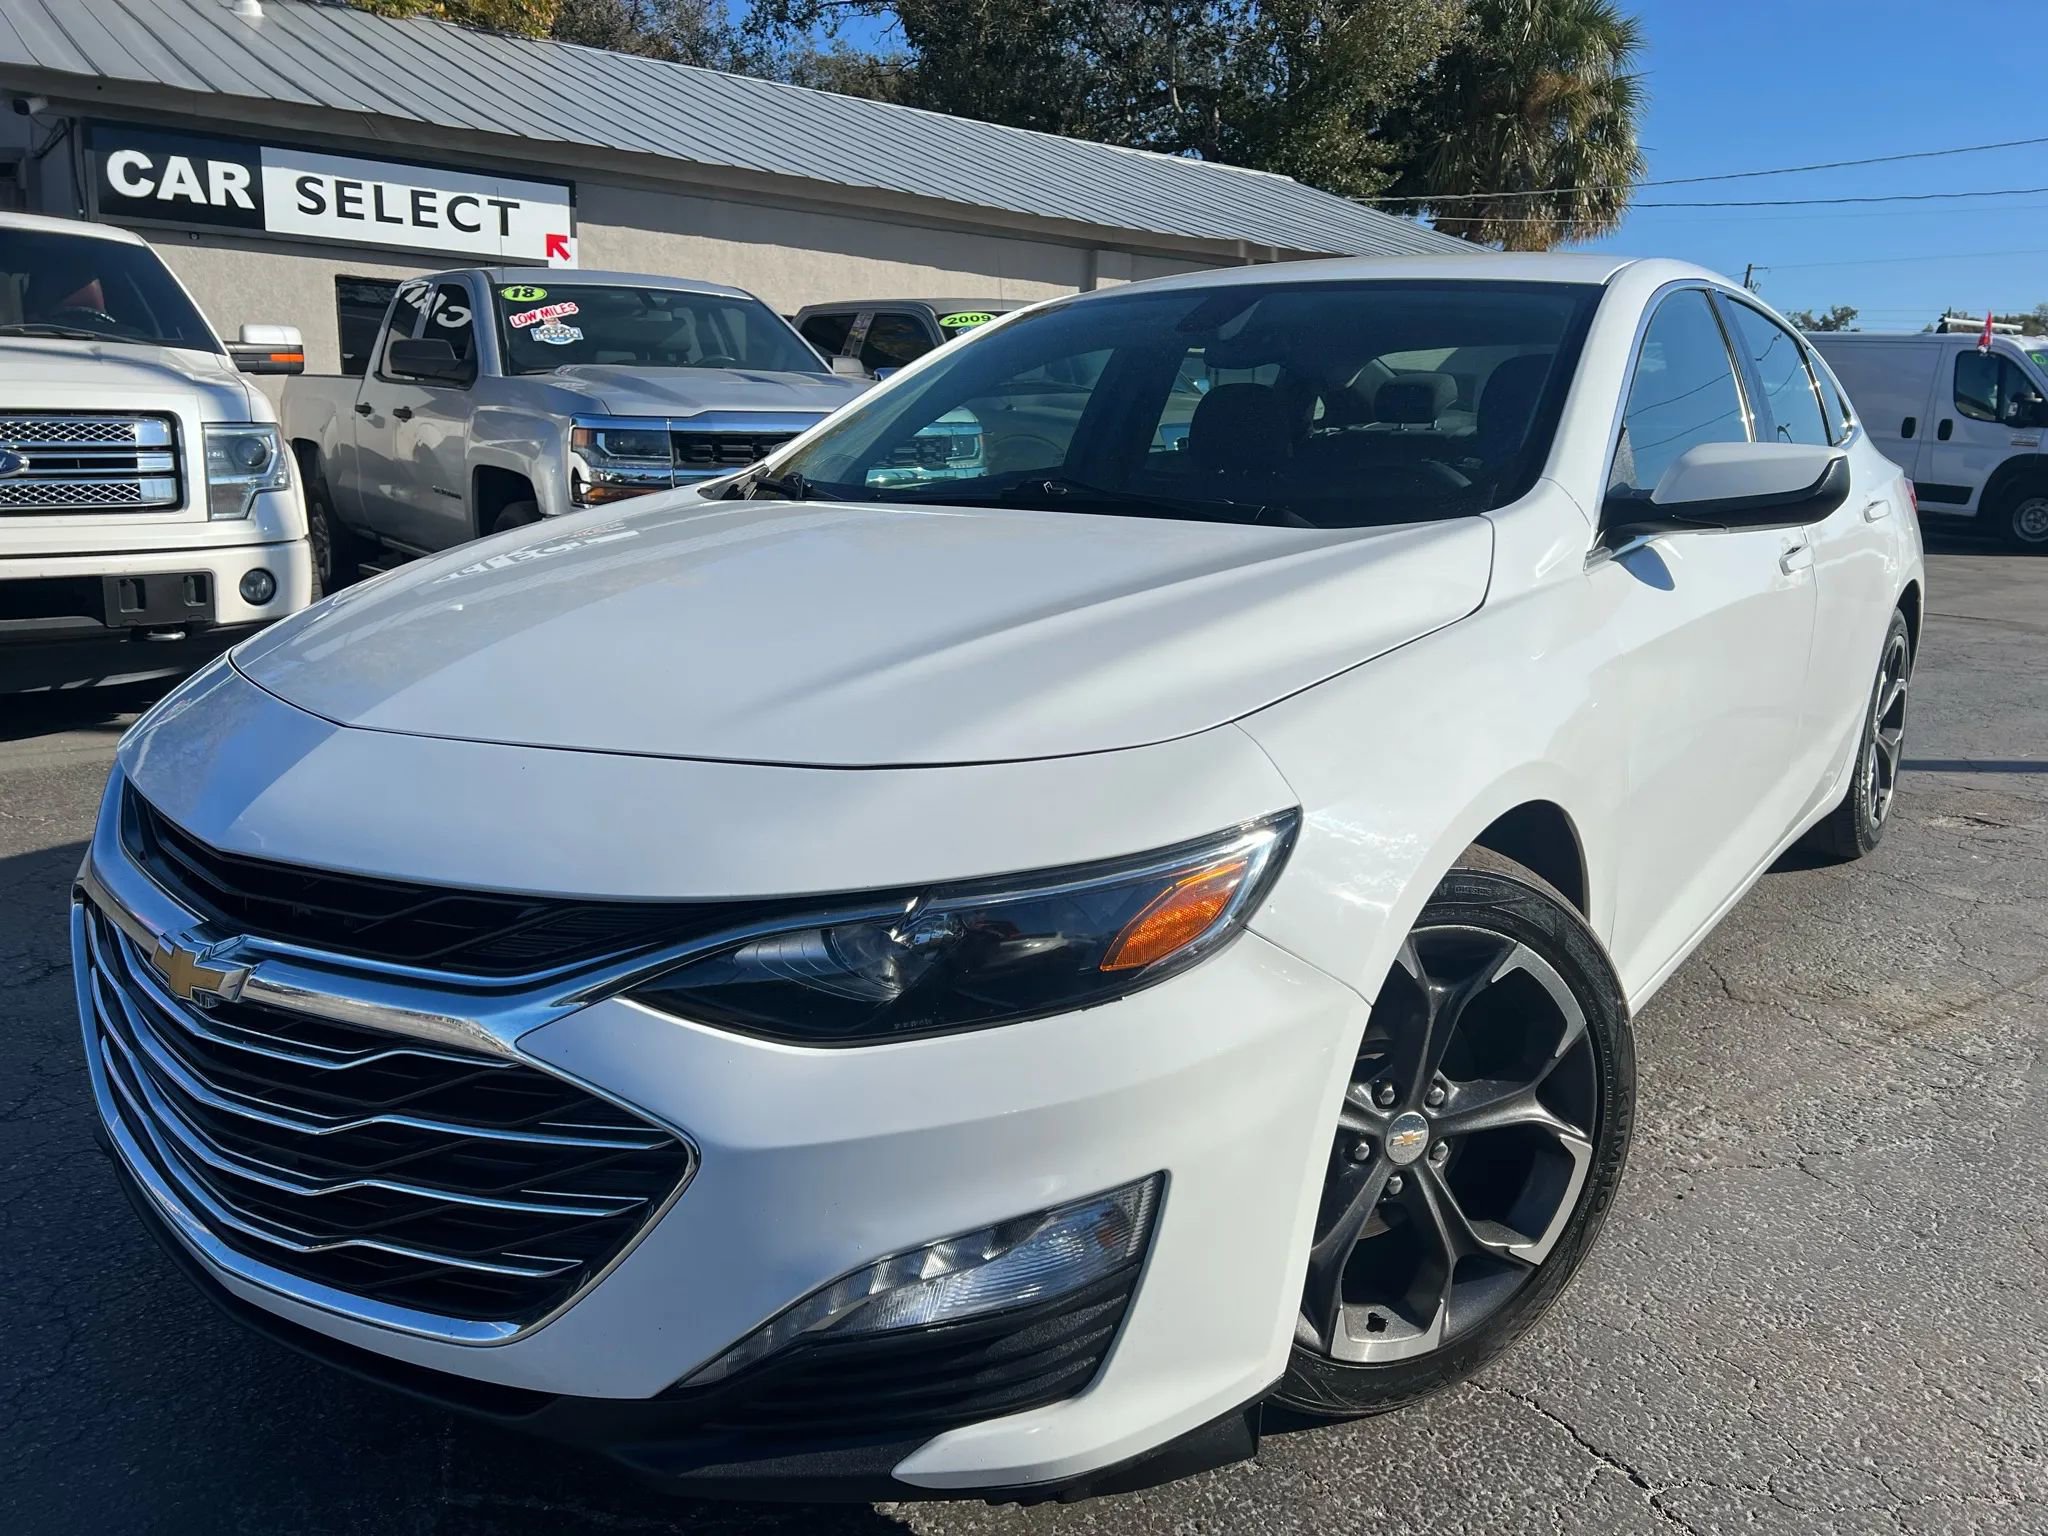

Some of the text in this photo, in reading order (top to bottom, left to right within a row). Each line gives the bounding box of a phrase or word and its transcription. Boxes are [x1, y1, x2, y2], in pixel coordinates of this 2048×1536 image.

[106, 149, 520, 237] CAR SELECT
[512, 287, 535, 298] 18
[511, 303, 577, 326] LOW MILES
[947, 315, 991, 325] 2009
[1594, 1086, 1630, 1215] KUMHO
